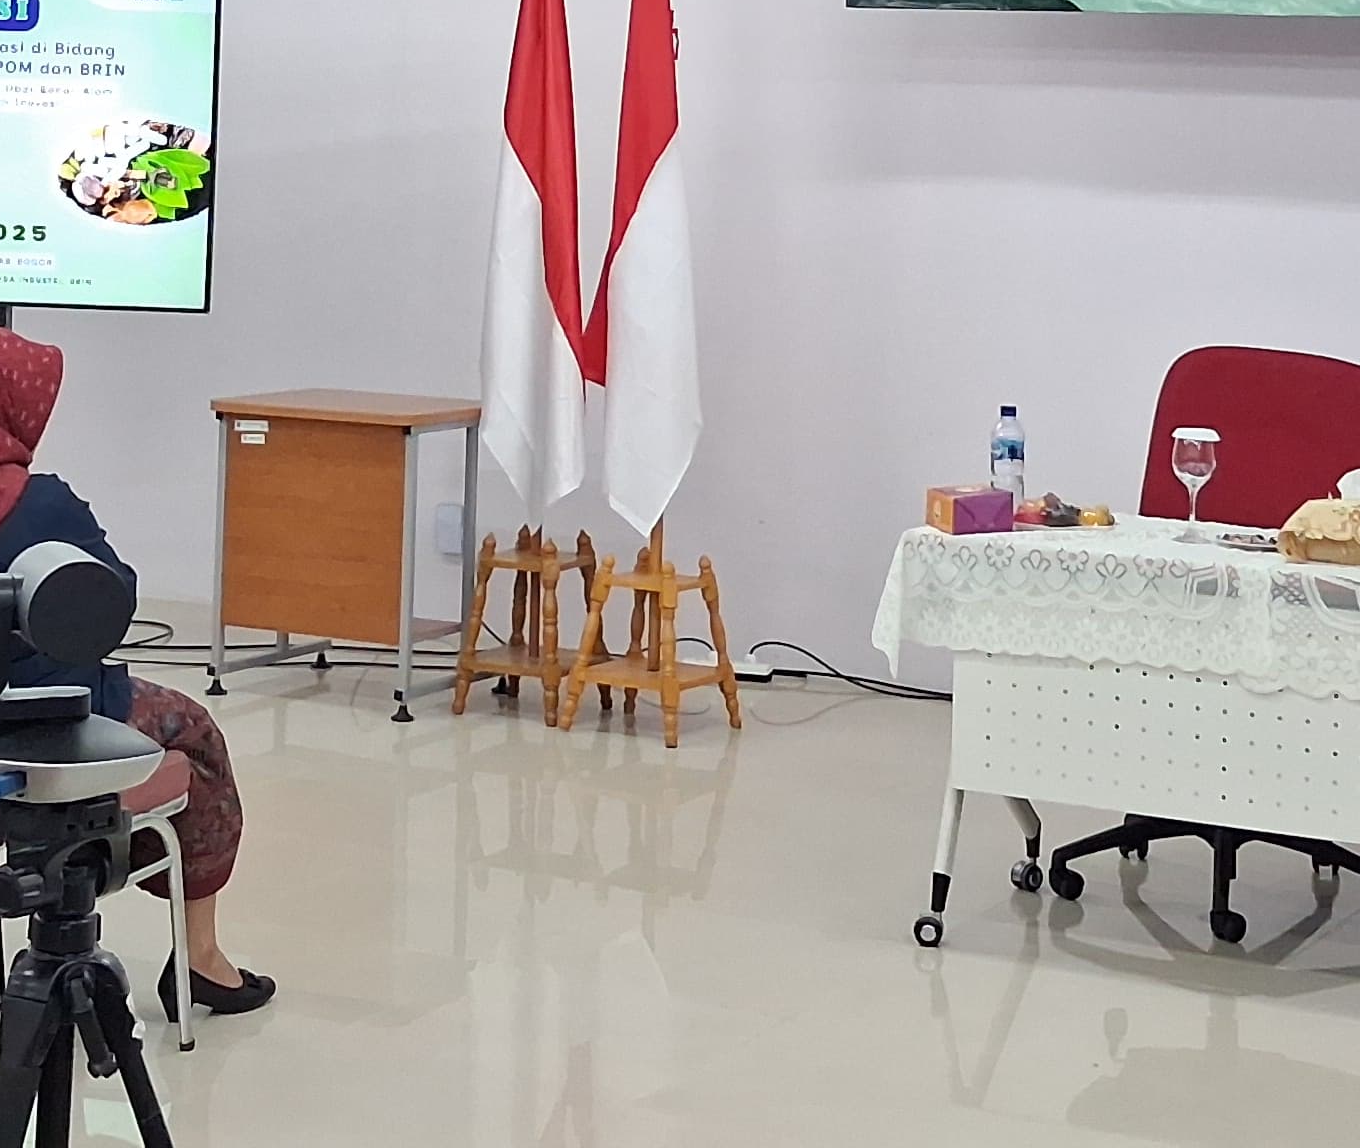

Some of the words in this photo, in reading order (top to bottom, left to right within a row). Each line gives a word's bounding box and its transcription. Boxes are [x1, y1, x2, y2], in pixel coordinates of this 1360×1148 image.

[31, 42, 47, 54] di
[55, 42, 115, 60] Bidang
[40, 62, 72, 75] dan
[80, 63, 125, 77] BRIN
